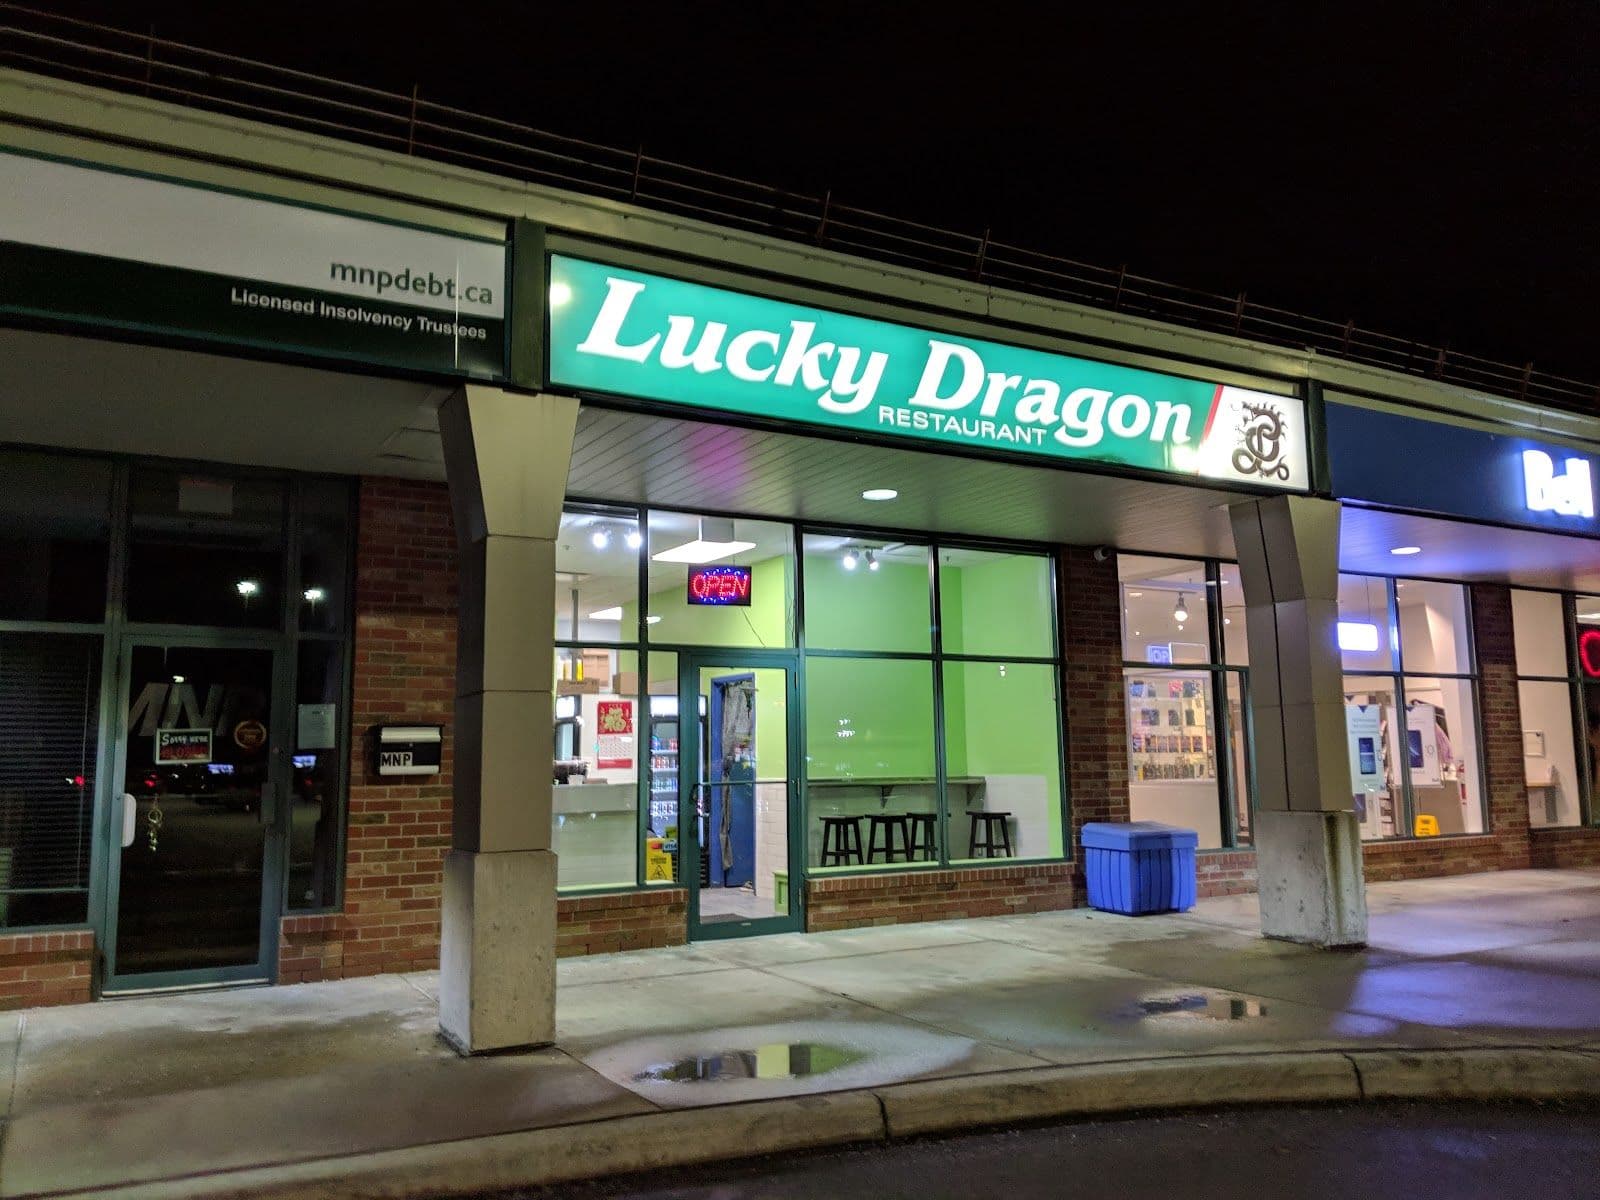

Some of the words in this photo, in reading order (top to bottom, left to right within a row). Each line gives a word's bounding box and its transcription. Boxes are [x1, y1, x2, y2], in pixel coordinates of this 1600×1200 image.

[330, 261, 493, 305] mnpdebt.ca
[230, 287, 316, 316] Licensed
[320, 301, 413, 332] Insolvency
[417, 316, 487, 340] Trustees
[576, 275, 890, 416] Lucky
[907, 339, 1196, 449] Dragon
[878, 406, 1048, 447] RESTAURANT
[693, 575, 748, 597] OPEN
[382, 753, 411, 767] MNP
